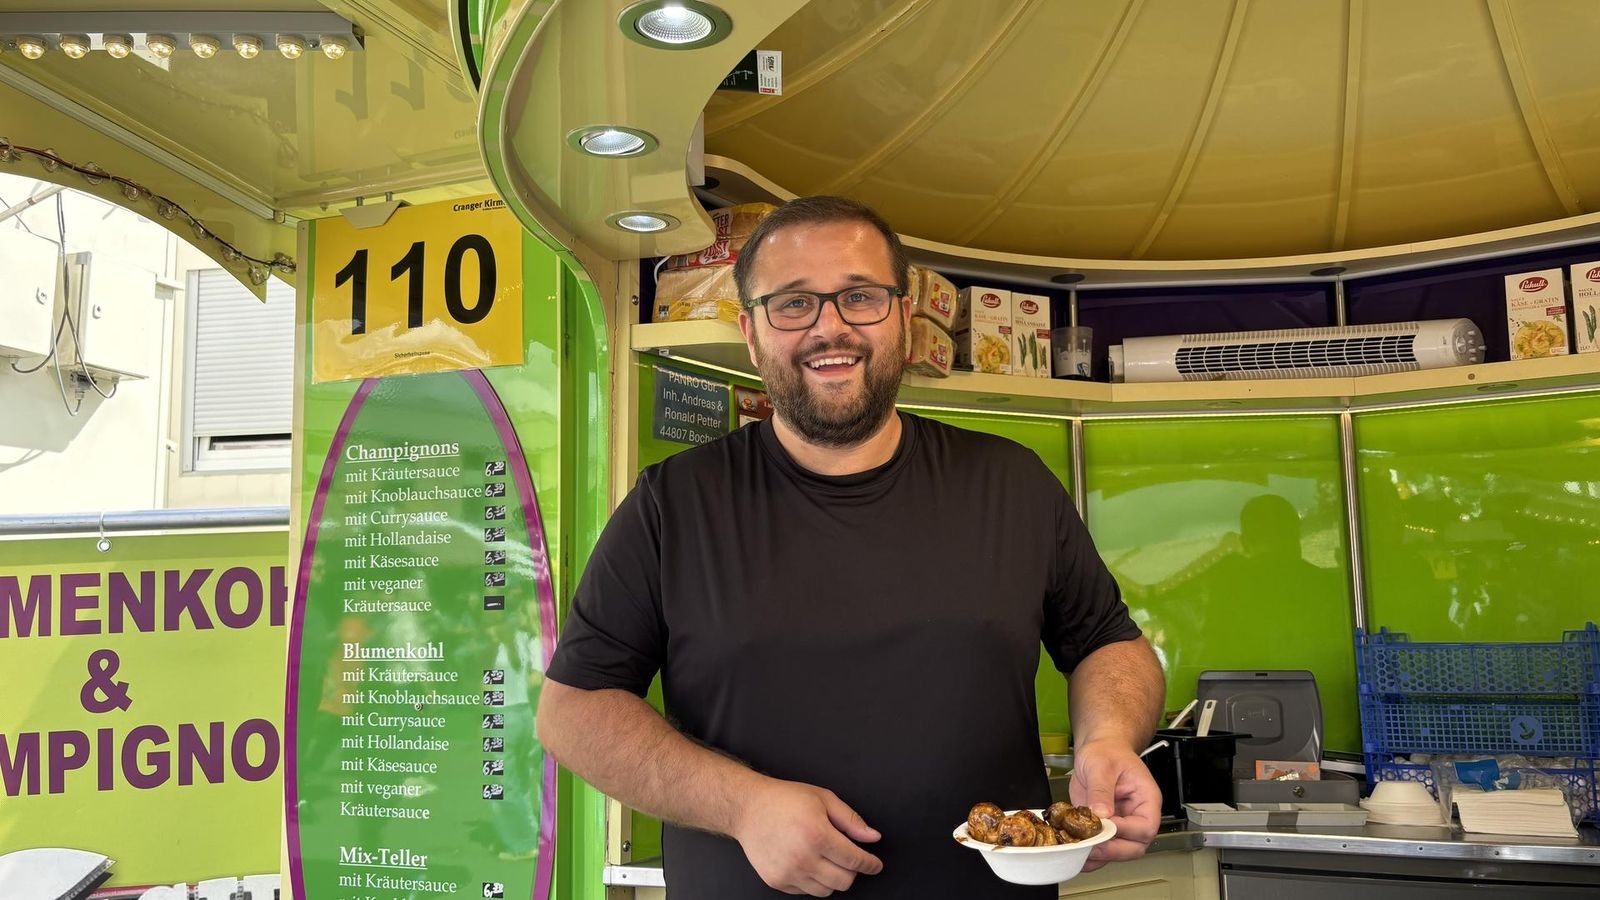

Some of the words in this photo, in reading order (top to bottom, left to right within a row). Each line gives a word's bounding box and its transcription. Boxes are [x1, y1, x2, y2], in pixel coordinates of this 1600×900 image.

[453, 201, 482, 211] Cranger
[335, 234, 496, 336] 110
[669, 372, 699, 388] PANRO
[663, 388, 680, 402] Inh.
[682, 393, 716, 410] Andreas
[717, 401, 724, 412] &
[664, 407, 695, 424] Ronald
[697, 414, 723, 429] Petter
[660, 425, 687, 440] 44807
[346, 442, 459, 462] Champignons
[345, 469, 367, 482] mit
[371, 467, 460, 482] Kräutersauce
[345, 491, 367, 504] mit
[371, 486, 482, 503] Knoblauchsauce
[345, 512, 367, 526] mit
[370, 511, 448, 528] Currysauce
[345, 534, 367, 547] mit
[370, 531, 452, 546] Hollandaise
[344, 555, 366, 569] mit
[370, 554, 439, 568] Käsesauce
[344, 577, 366, 590] mit
[370, 579, 424, 594] veganer
[344, 599, 432, 613] Kräutersauce
[343, 642, 445, 659] Blumenkohl
[80, 649, 133, 713] &
[342, 669, 366, 682] mit
[368, 668, 459, 682] Kräutersauce
[342, 690, 365, 704] mit
[368, 690, 480, 705] Knoblauchsauce
[342, 713, 364, 726] mit
[368, 713, 446, 732] Currysauce
[341, 735, 364, 749] mit
[368, 735, 450, 751] Hollandaise
[341, 758, 363, 771] mit
[367, 757, 437, 774] Käsesauce
[341, 780, 363, 794] mit
[367, 784, 422, 800] veganer
[340, 802, 430, 819] Kräutersauce
[339, 846, 428, 867] Mix-Teller
[339, 873, 362, 887] mit
[366, 873, 457, 893] Kräutersauce
